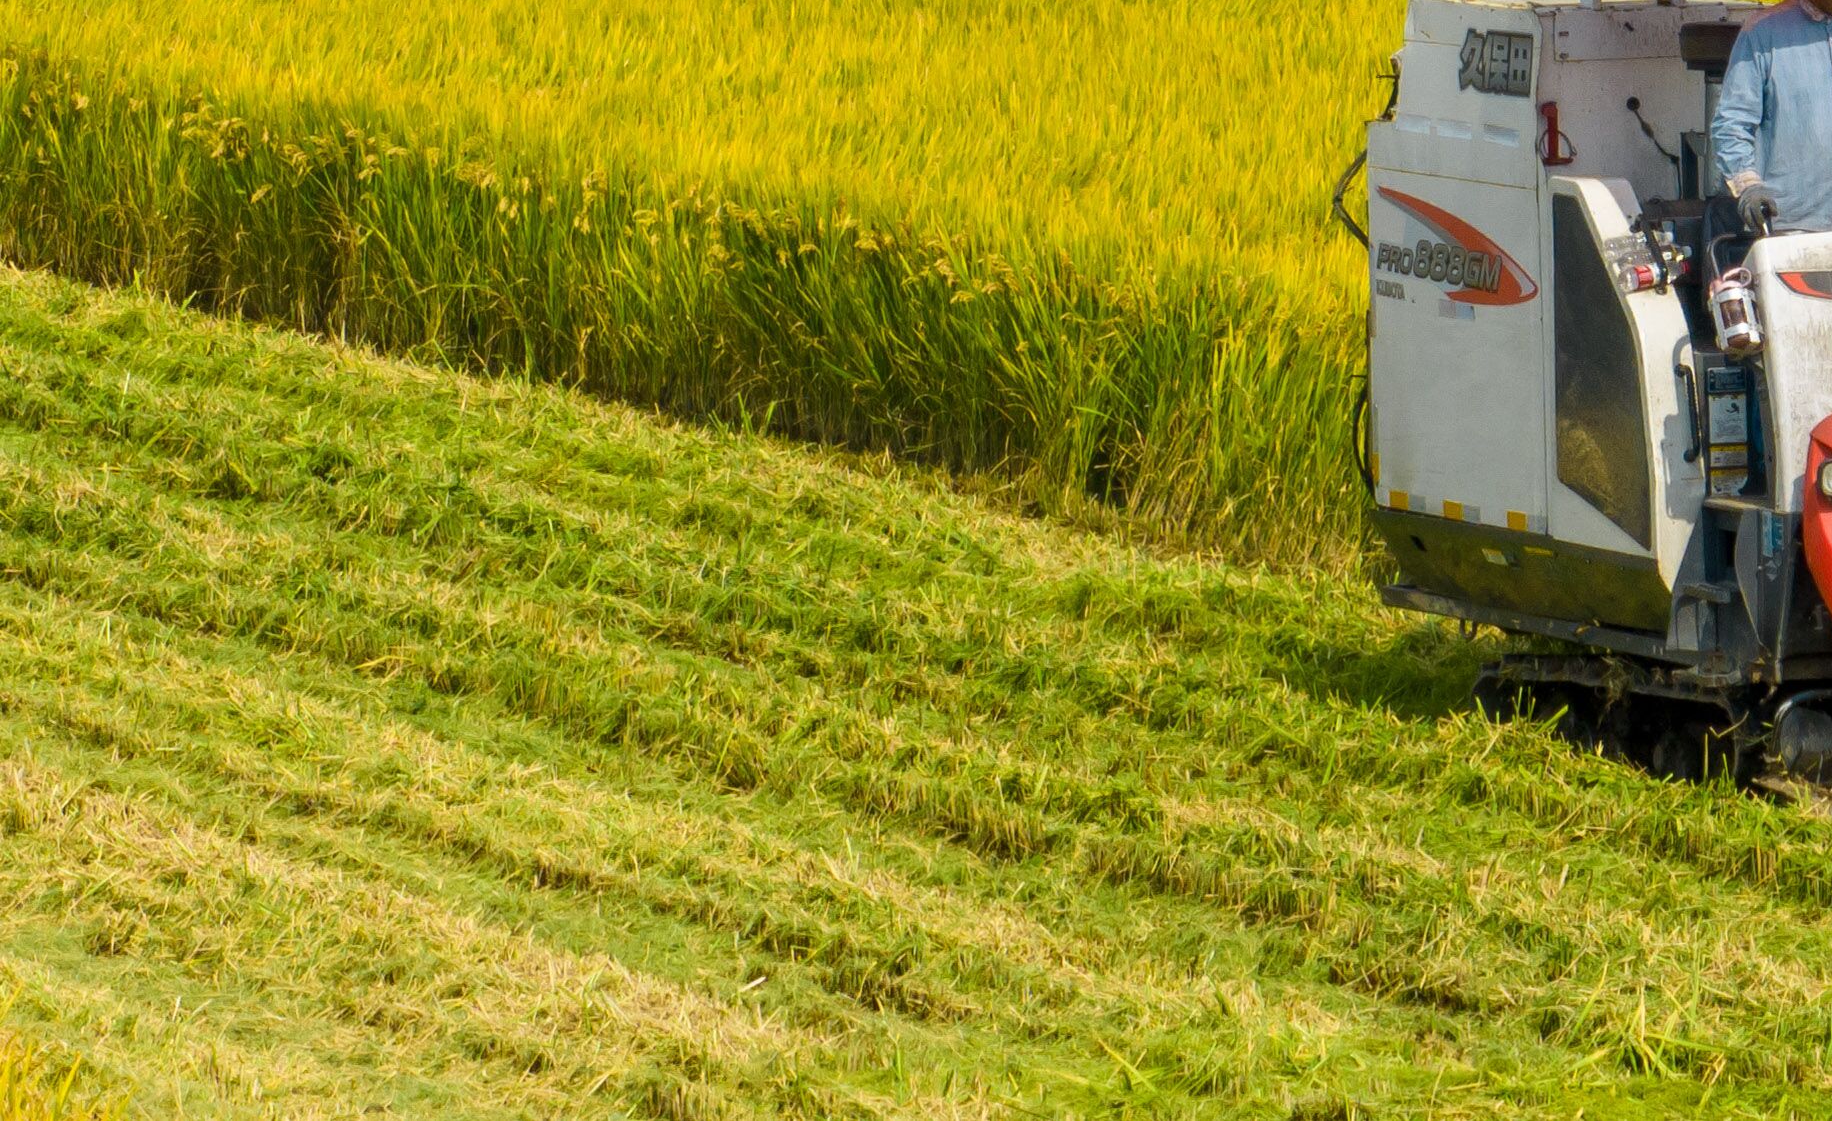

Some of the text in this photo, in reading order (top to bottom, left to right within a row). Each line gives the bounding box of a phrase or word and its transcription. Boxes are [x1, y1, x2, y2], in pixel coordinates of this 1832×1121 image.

[1459, 28, 1533, 98] 久保田
[1376, 239, 1503, 294] PRO888GM
